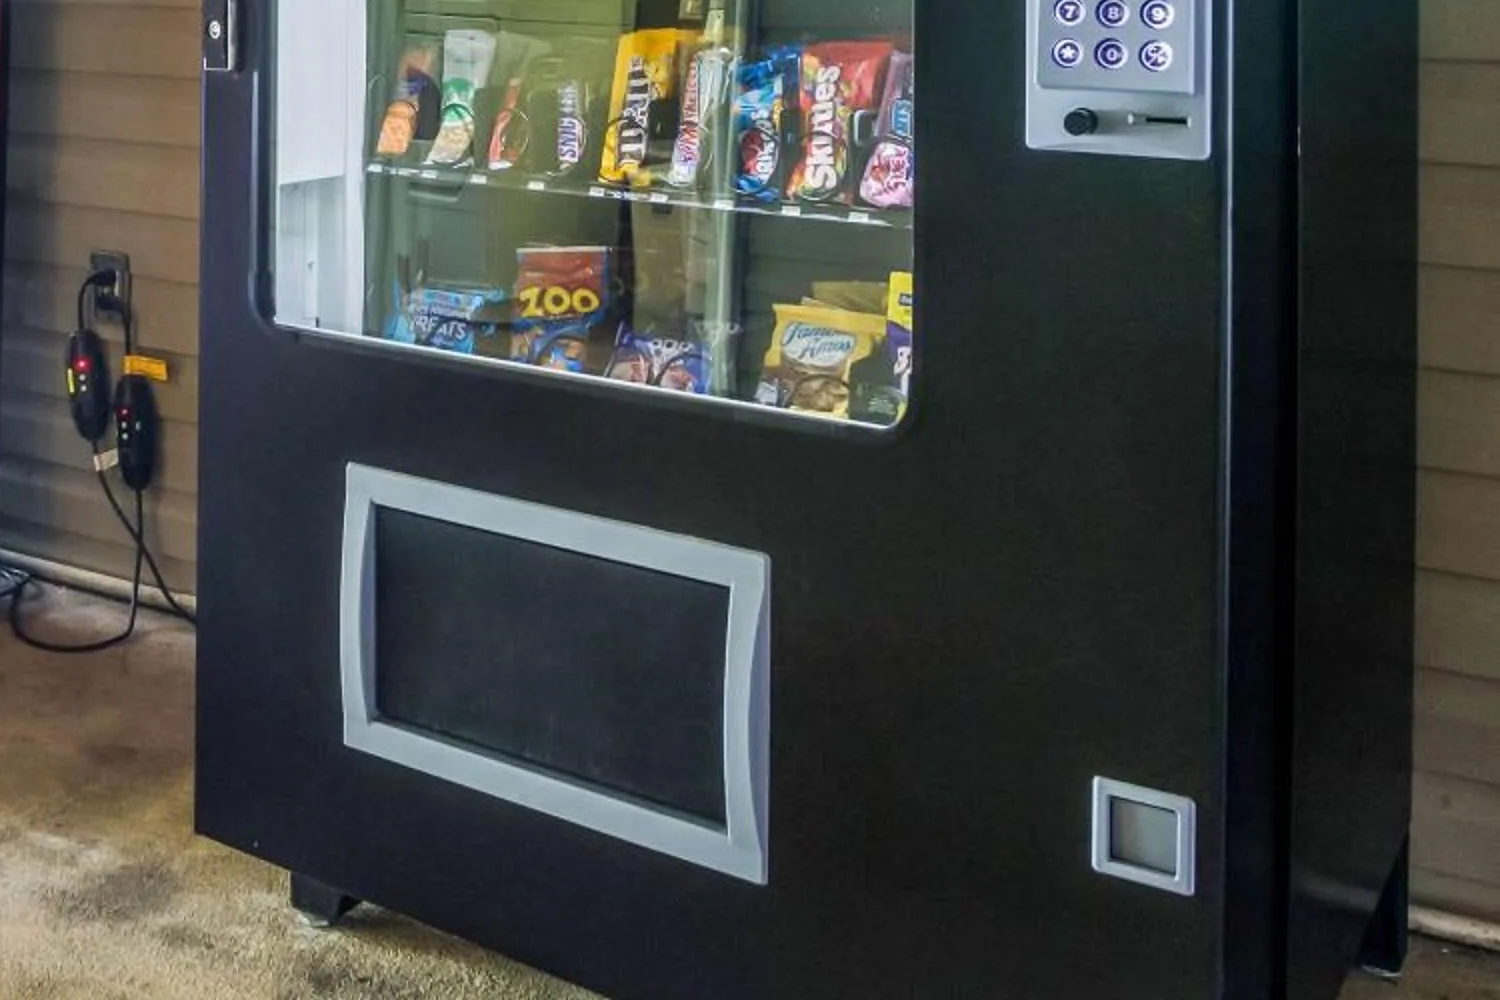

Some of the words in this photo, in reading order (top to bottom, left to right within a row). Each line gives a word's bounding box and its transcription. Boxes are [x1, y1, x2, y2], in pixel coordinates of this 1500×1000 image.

[1064, 5, 1076, 19] 7
[1106, 6, 1118, 20] 8
[1152, 6, 1164, 21] 9
